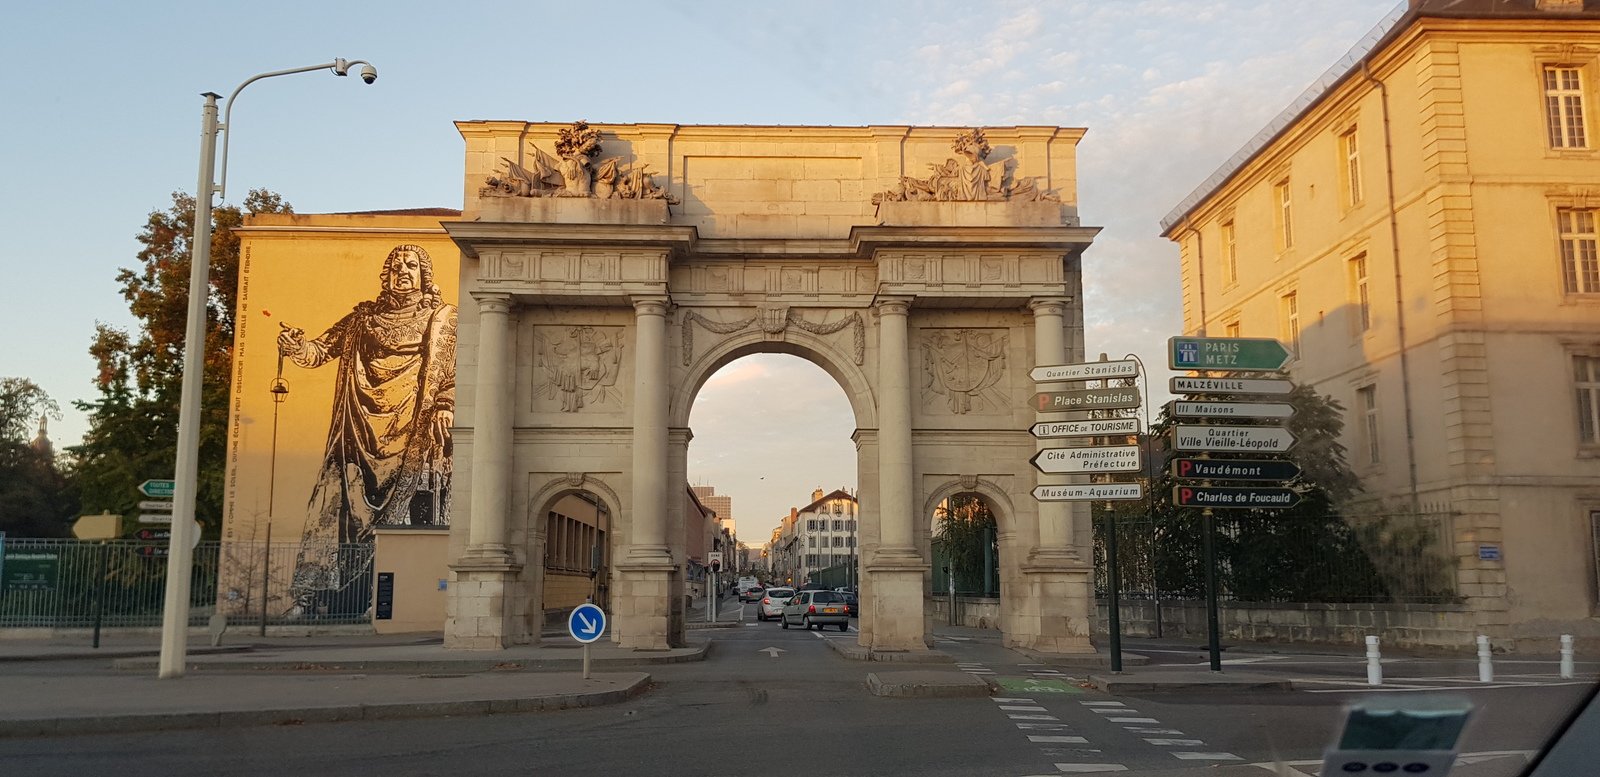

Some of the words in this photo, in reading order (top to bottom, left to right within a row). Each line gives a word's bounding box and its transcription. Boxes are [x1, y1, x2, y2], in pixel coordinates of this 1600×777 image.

[1206, 342, 1239, 352] PARIS
[1206, 355, 1237, 364] METZ
[1046, 369, 1080, 377] Quartier
[1084, 364, 1132, 375] Stanislas
[1178, 380, 1243, 389] MALZÉVILLE
[1039, 394, 1050, 409] P
[1054, 396, 1082, 406] Place
[1086, 393, 1133, 404] Stanislas
[1195, 405, 1234, 414] Maisons
[1052, 424, 1079, 433] OFFICE
[1090, 422, 1134, 431] TOURISME
[1208, 428, 1249, 437] Quartier
[1180, 437, 1201, 446] Ville
[1205, 437, 1278, 449] Vieille-Léopold
[1047, 452, 1065, 460] Cité
[1070, 449, 1136, 459] Administrative
[1083, 460, 1136, 469] Préfecture
[1181, 460, 1192, 476] P
[1195, 464, 1261, 475] Vaudémont
[1182, 488, 1193, 504] P
[1196, 492, 1233, 502] Charles
[1235, 492, 1246, 502] de
[1250, 493, 1290, 502] Foucauld
